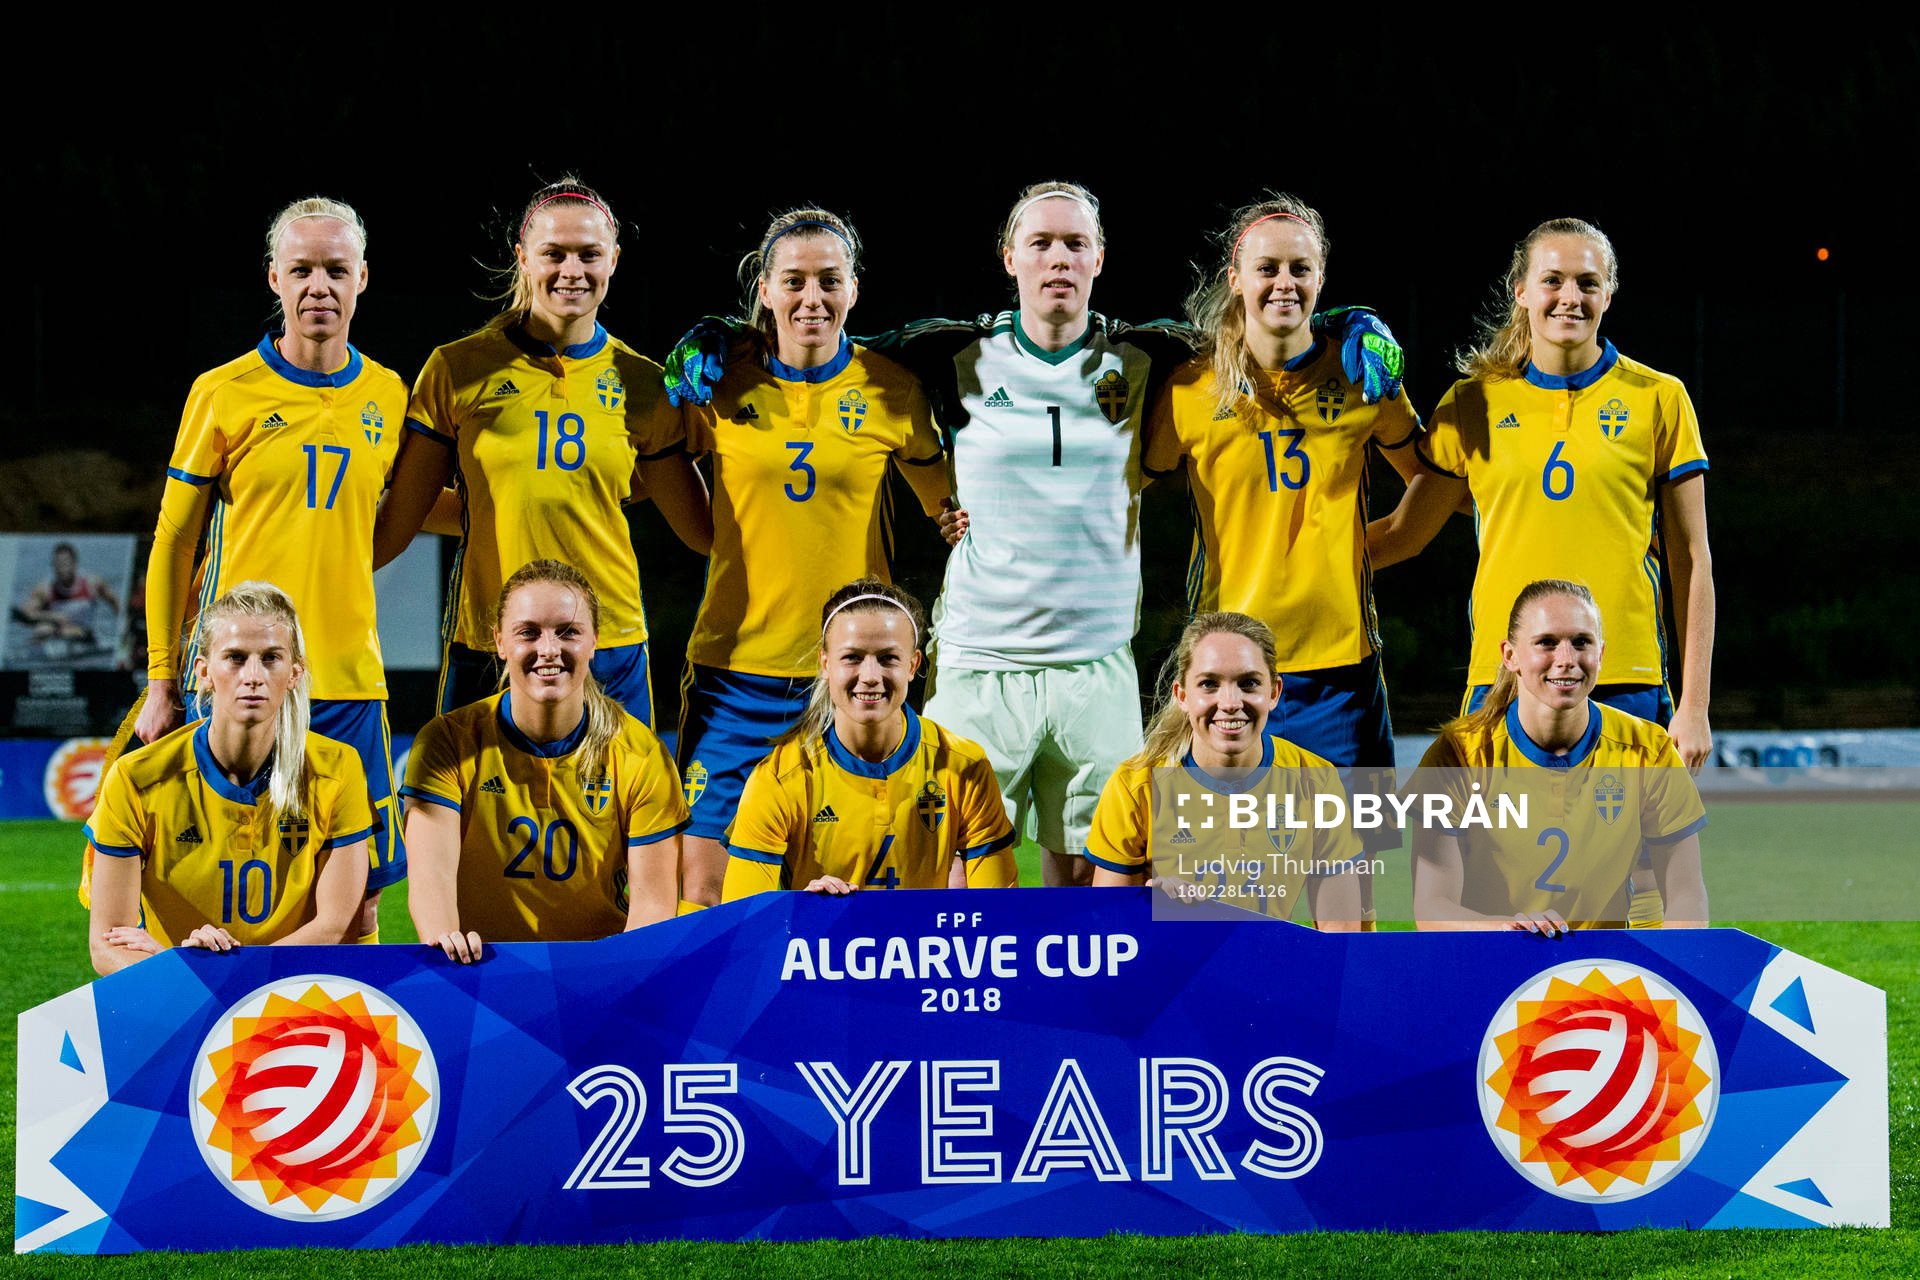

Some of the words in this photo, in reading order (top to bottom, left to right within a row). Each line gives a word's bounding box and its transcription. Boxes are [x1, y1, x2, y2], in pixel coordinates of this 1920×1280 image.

[261, 421, 288, 429] adidas
[984, 399, 1014, 407] adidas
[534, 410, 586, 471] 18
[1046, 406, 1061, 467] 1
[1258, 428, 1311, 492] 13
[302, 444, 351, 510] 17
[784, 441, 817, 502] 3
[1542, 441, 1575, 501] 6
[480, 784, 506, 794] adidas
[813, 815, 839, 823] adidas
[503, 816, 579, 881] 20
[865, 834, 900, 889] 4
[1535, 827, 1570, 893] 2
[218, 859, 272, 924] 10
[936, 912, 982, 928] FPF
[780, 935, 1018, 981] ALGARVE
[1036, 933, 1139, 977] CUP
[921, 987, 1001, 1012] 2018
[562, 1062, 746, 1190] 25
[794, 1055, 1326, 1186] YEARS
